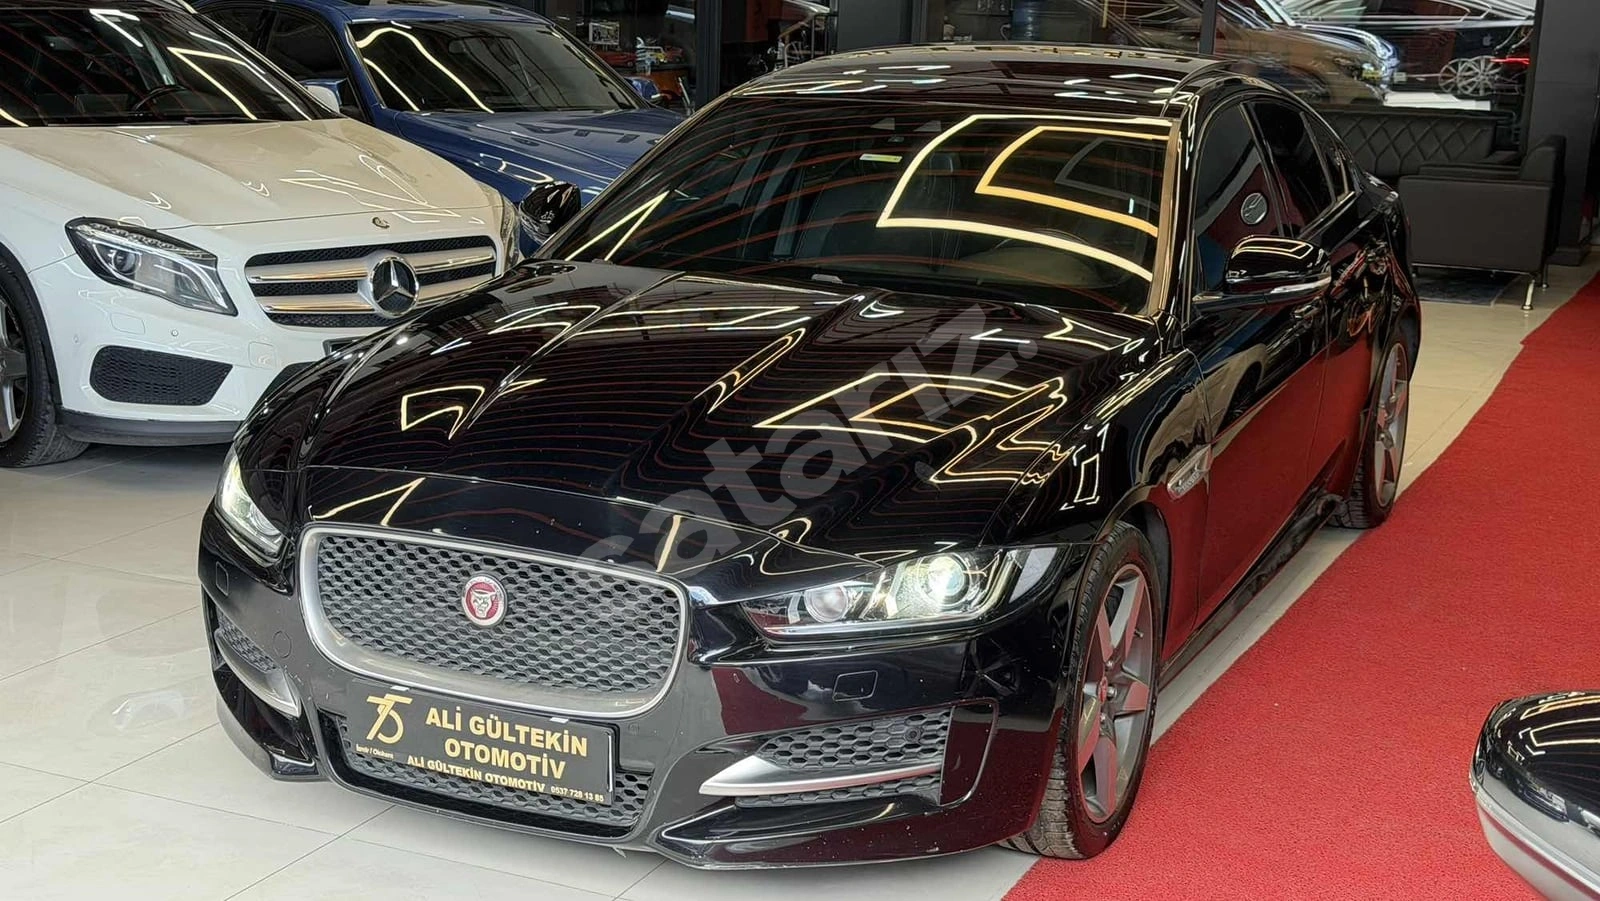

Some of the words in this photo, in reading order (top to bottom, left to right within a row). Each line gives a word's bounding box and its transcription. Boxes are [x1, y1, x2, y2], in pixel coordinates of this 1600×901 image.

[425, 706, 462, 732] ALİ
[469, 714, 588, 757] GÜLTEKİN
[407, 755, 425, 768] ALİ
[427, 759, 482, 781] GÜLTEKİN
[485, 772, 546, 792] OTOMOTİV
[444, 738, 566, 779] OTOMOTİV
